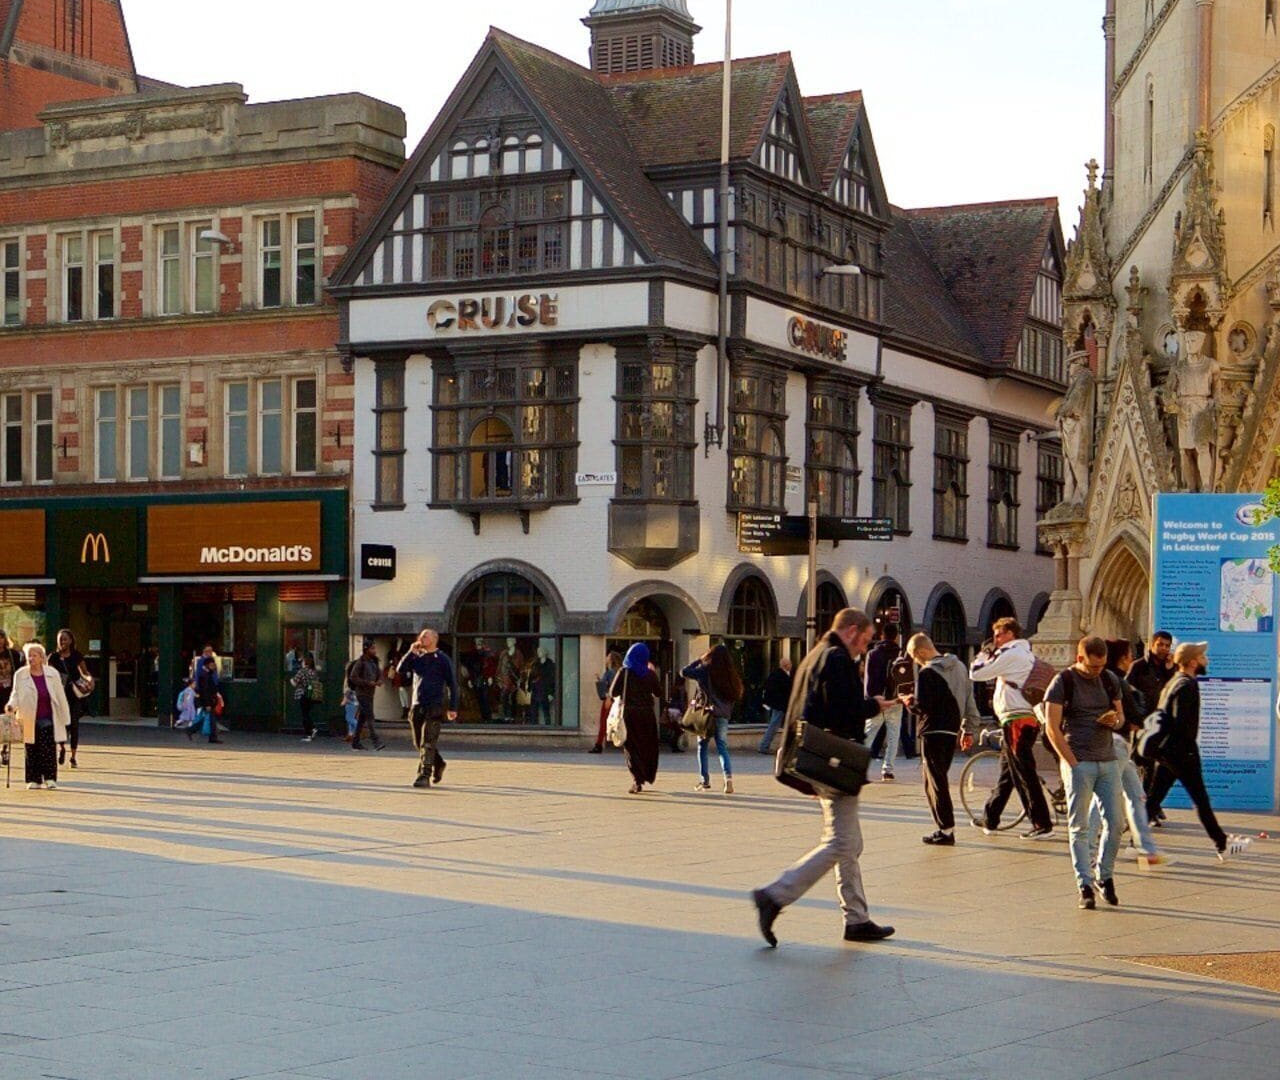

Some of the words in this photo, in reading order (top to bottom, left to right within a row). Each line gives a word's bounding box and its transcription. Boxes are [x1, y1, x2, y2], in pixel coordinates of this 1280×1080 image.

[426, 294, 559, 332] CRUISE
[787, 315, 848, 361] CRUISE
[1163, 521, 1208, 529] Welcome
[1211, 521, 1223, 529] to
[1163, 532, 1195, 541] Rugby
[1198, 532, 1227, 540] World
[1230, 532, 1248, 541] Cup
[1251, 532, 1275, 541] 2015
[1163, 543, 1172, 551] in
[1174, 543, 1220, 551] Leicester
[200, 546, 312, 563] McDonald's
[367, 557, 391, 567] CRUISE
